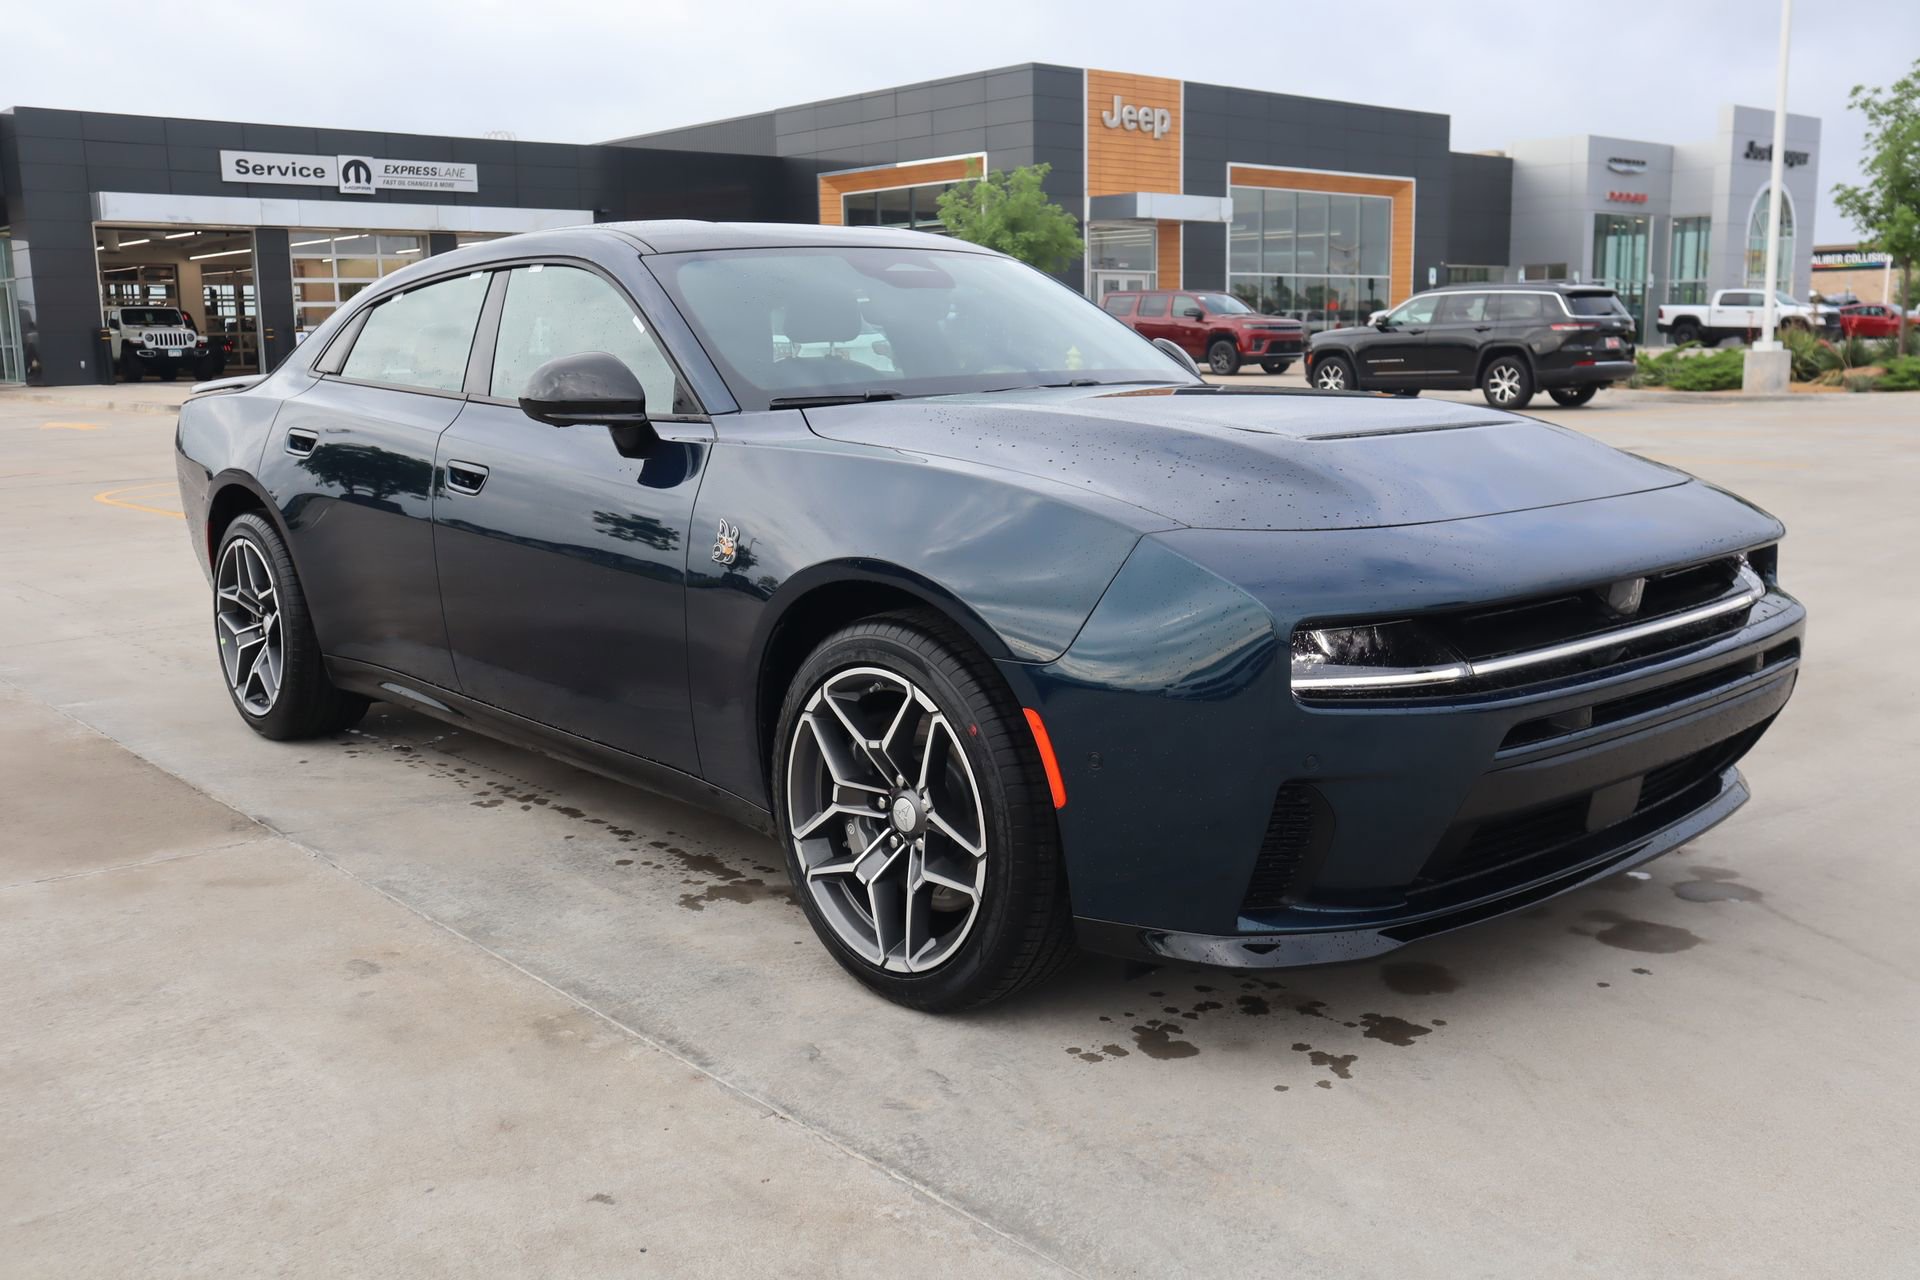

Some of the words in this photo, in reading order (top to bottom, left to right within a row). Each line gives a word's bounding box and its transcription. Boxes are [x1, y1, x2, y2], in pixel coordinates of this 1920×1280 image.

[1102, 95, 1171, 140] Jeep
[235, 158, 326, 179] Service
[383, 164, 466, 179] EXPRESSLANE
[407, 180, 433, 188] CHANGES
[1811, 254, 1843, 265] ALIBER
